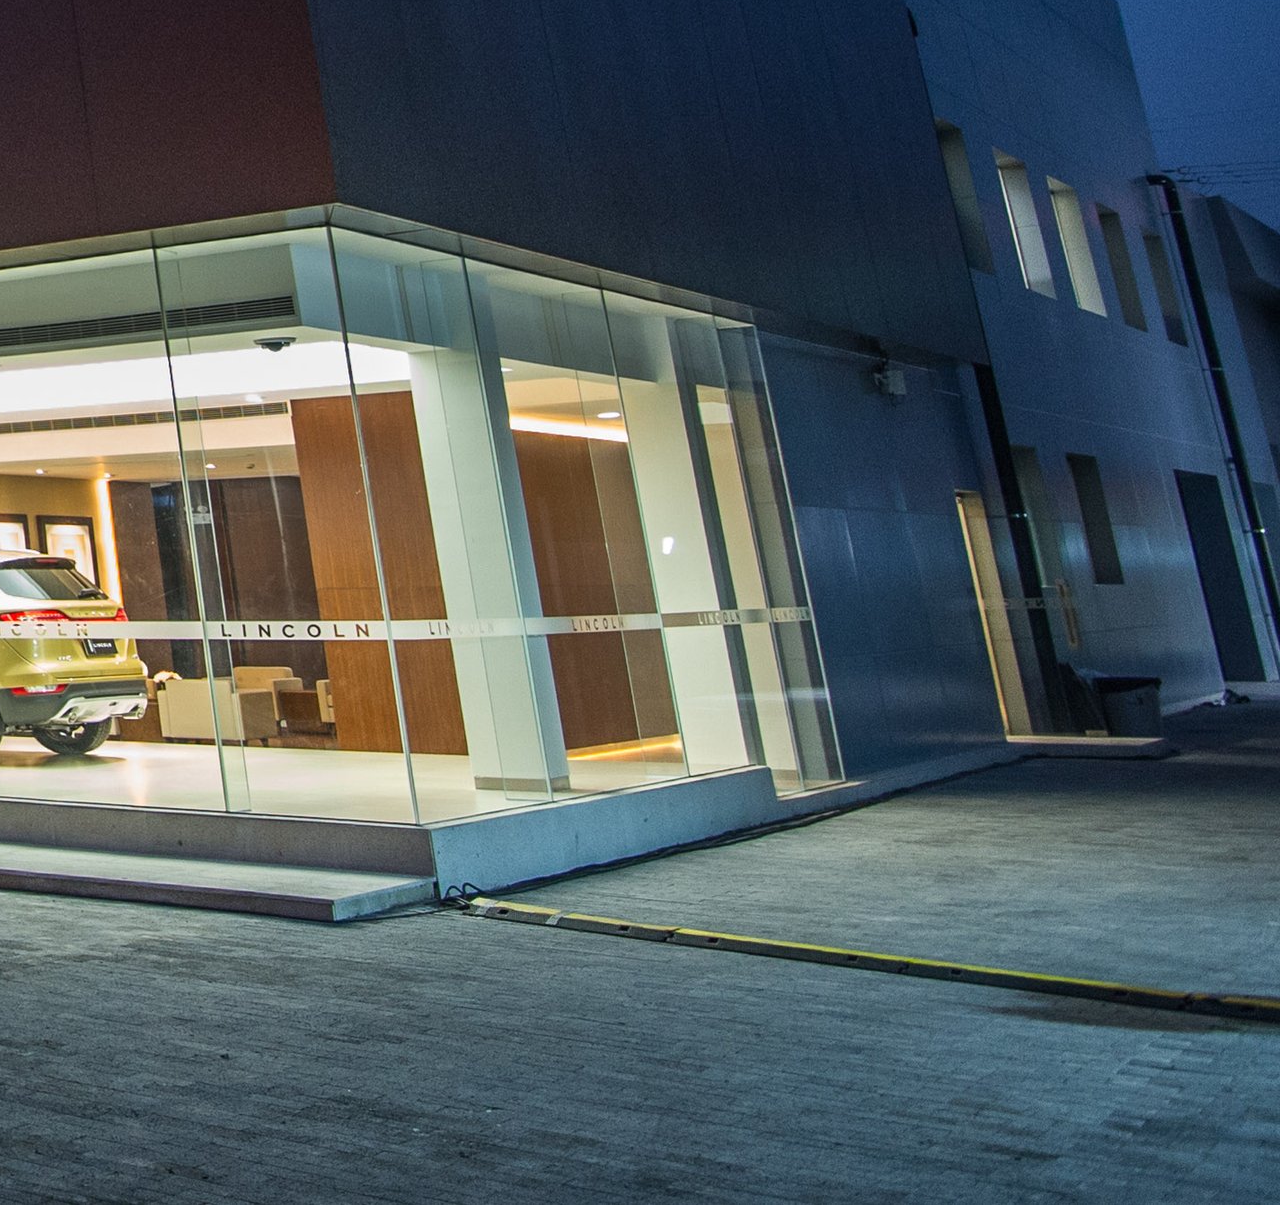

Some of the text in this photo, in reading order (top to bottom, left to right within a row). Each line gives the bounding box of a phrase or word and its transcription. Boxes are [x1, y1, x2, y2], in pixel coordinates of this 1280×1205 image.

[571, 615, 624, 632] LINCOLN
[697, 612, 740, 625] LINCOLN
[221, 624, 370, 637] LINCOLN
